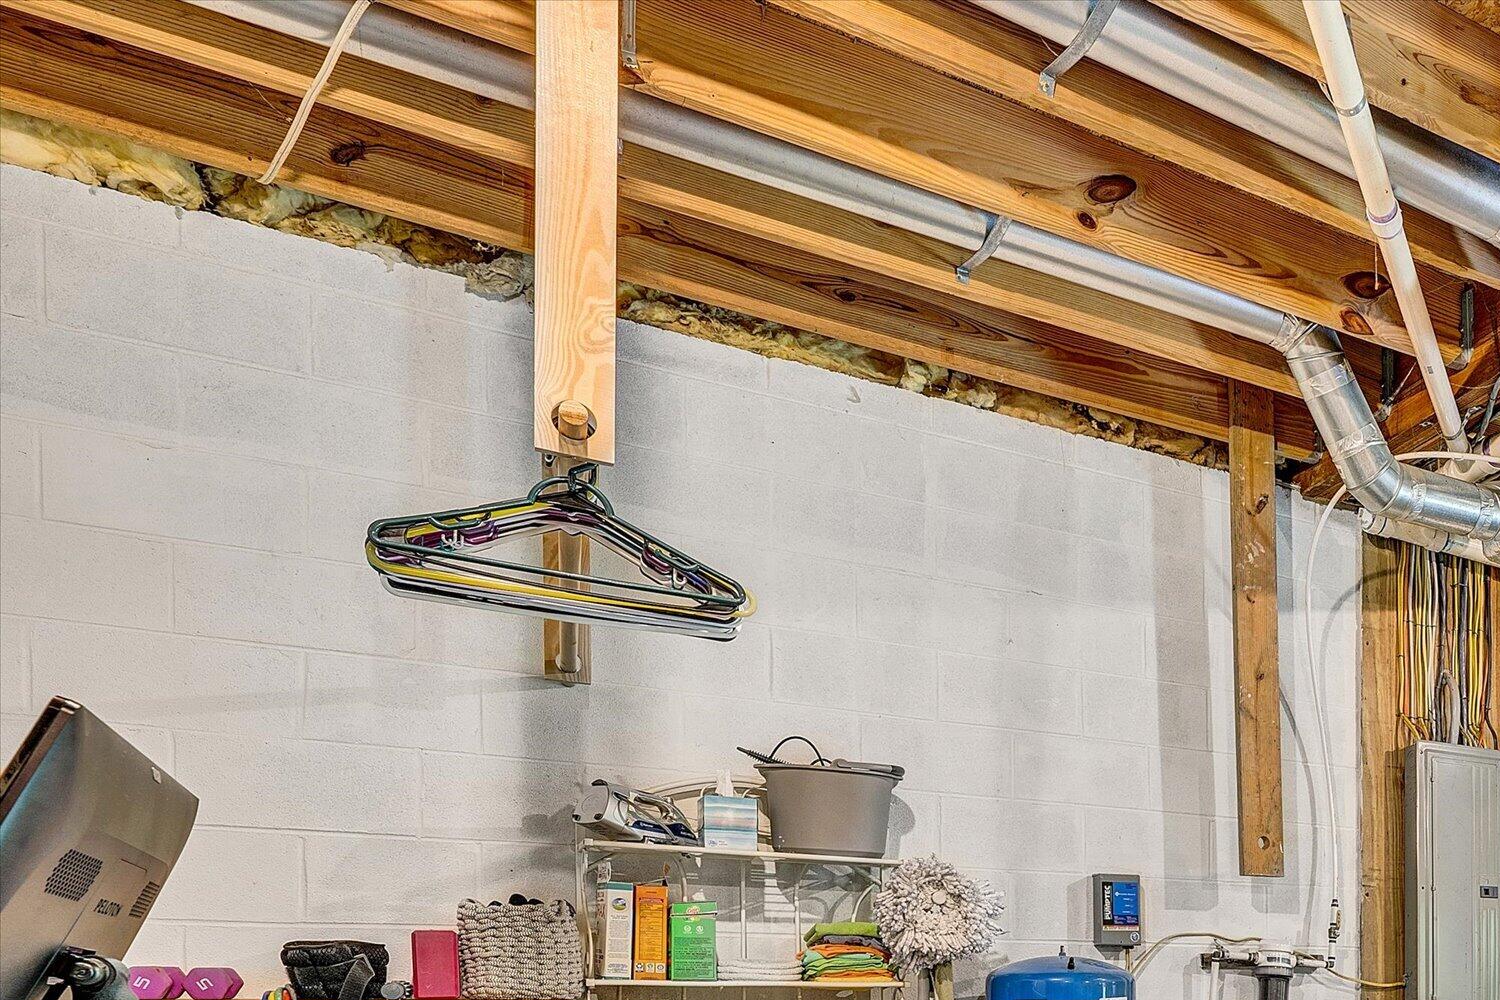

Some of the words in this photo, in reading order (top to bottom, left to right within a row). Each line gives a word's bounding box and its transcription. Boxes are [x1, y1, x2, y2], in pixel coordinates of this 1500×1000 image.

[93, 898, 123, 917] PELOTON
[1103, 885, 1113, 920] PUMPTEC
[133, 976, 151, 990] 5
[195, 977, 214, 991] 5
